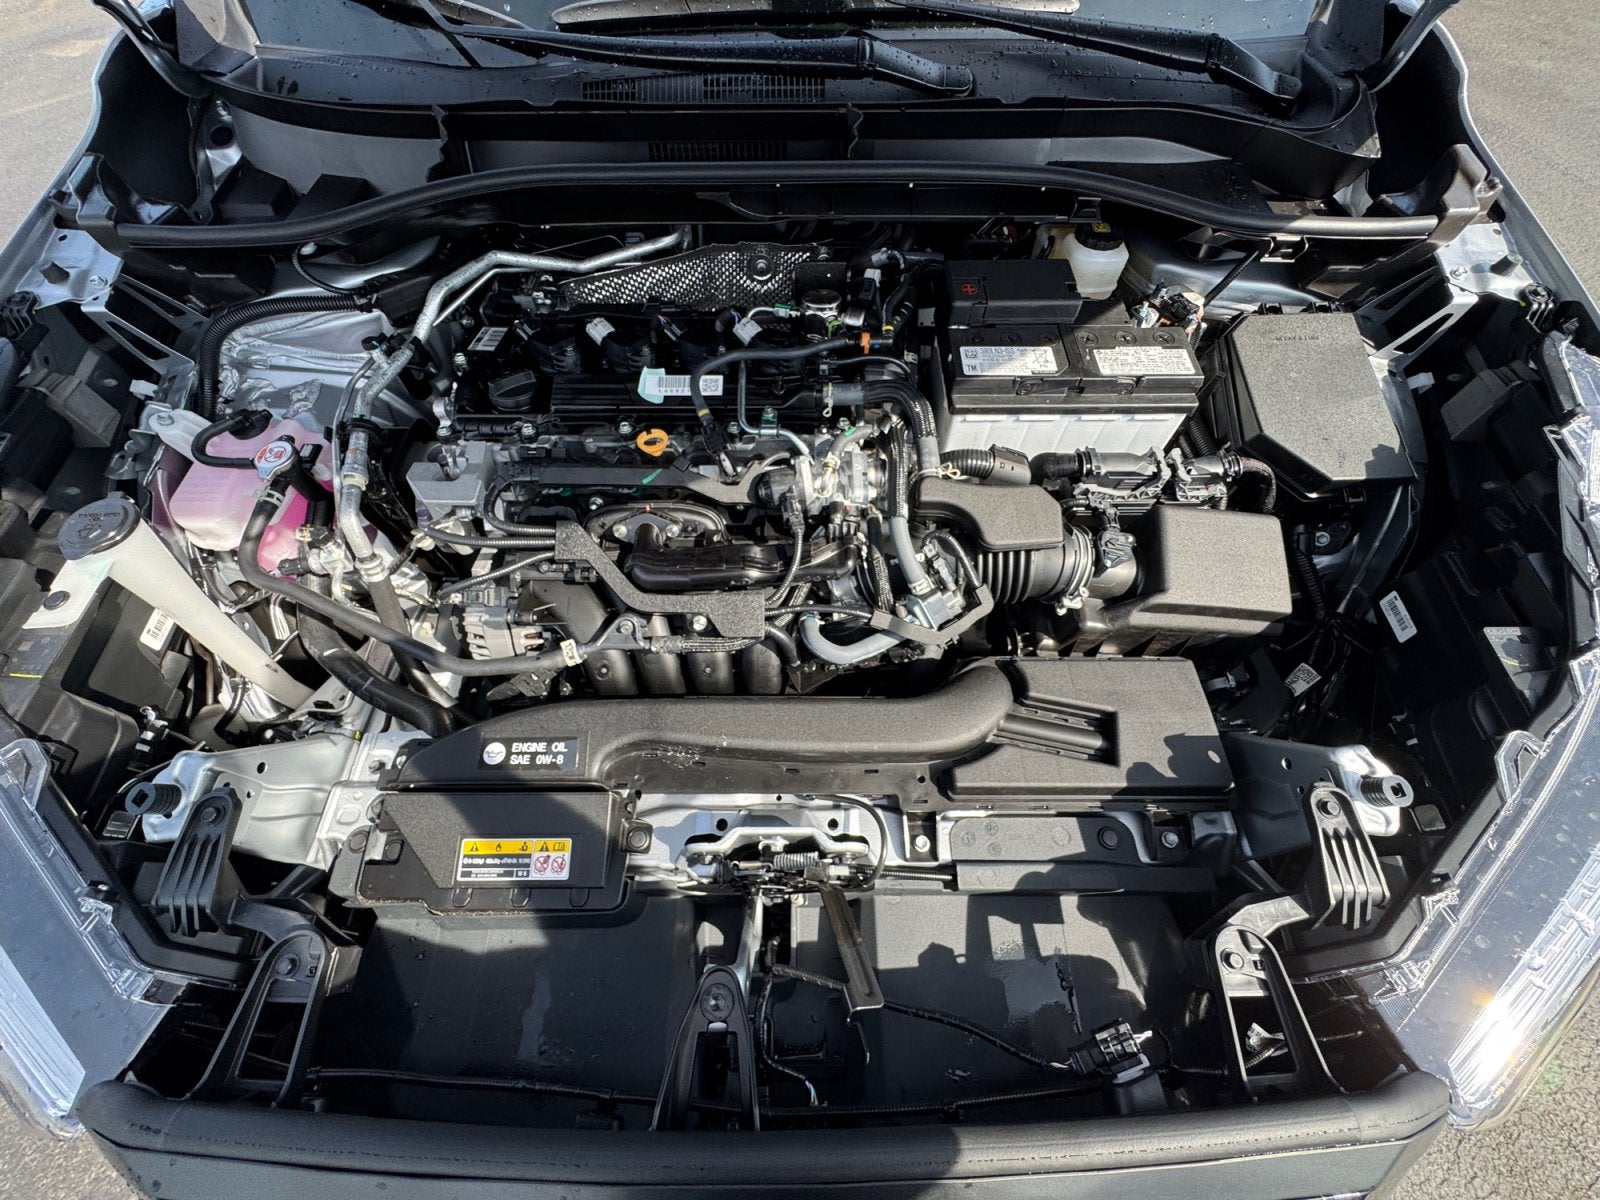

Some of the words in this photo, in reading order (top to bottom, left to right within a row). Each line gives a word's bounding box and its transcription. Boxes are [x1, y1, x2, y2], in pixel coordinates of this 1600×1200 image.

[511, 742, 548, 752] ENGINE
[552, 742, 568, 752] OIL
[509, 755, 531, 765] SAE
[535, 755, 564, 765] 0W-8
